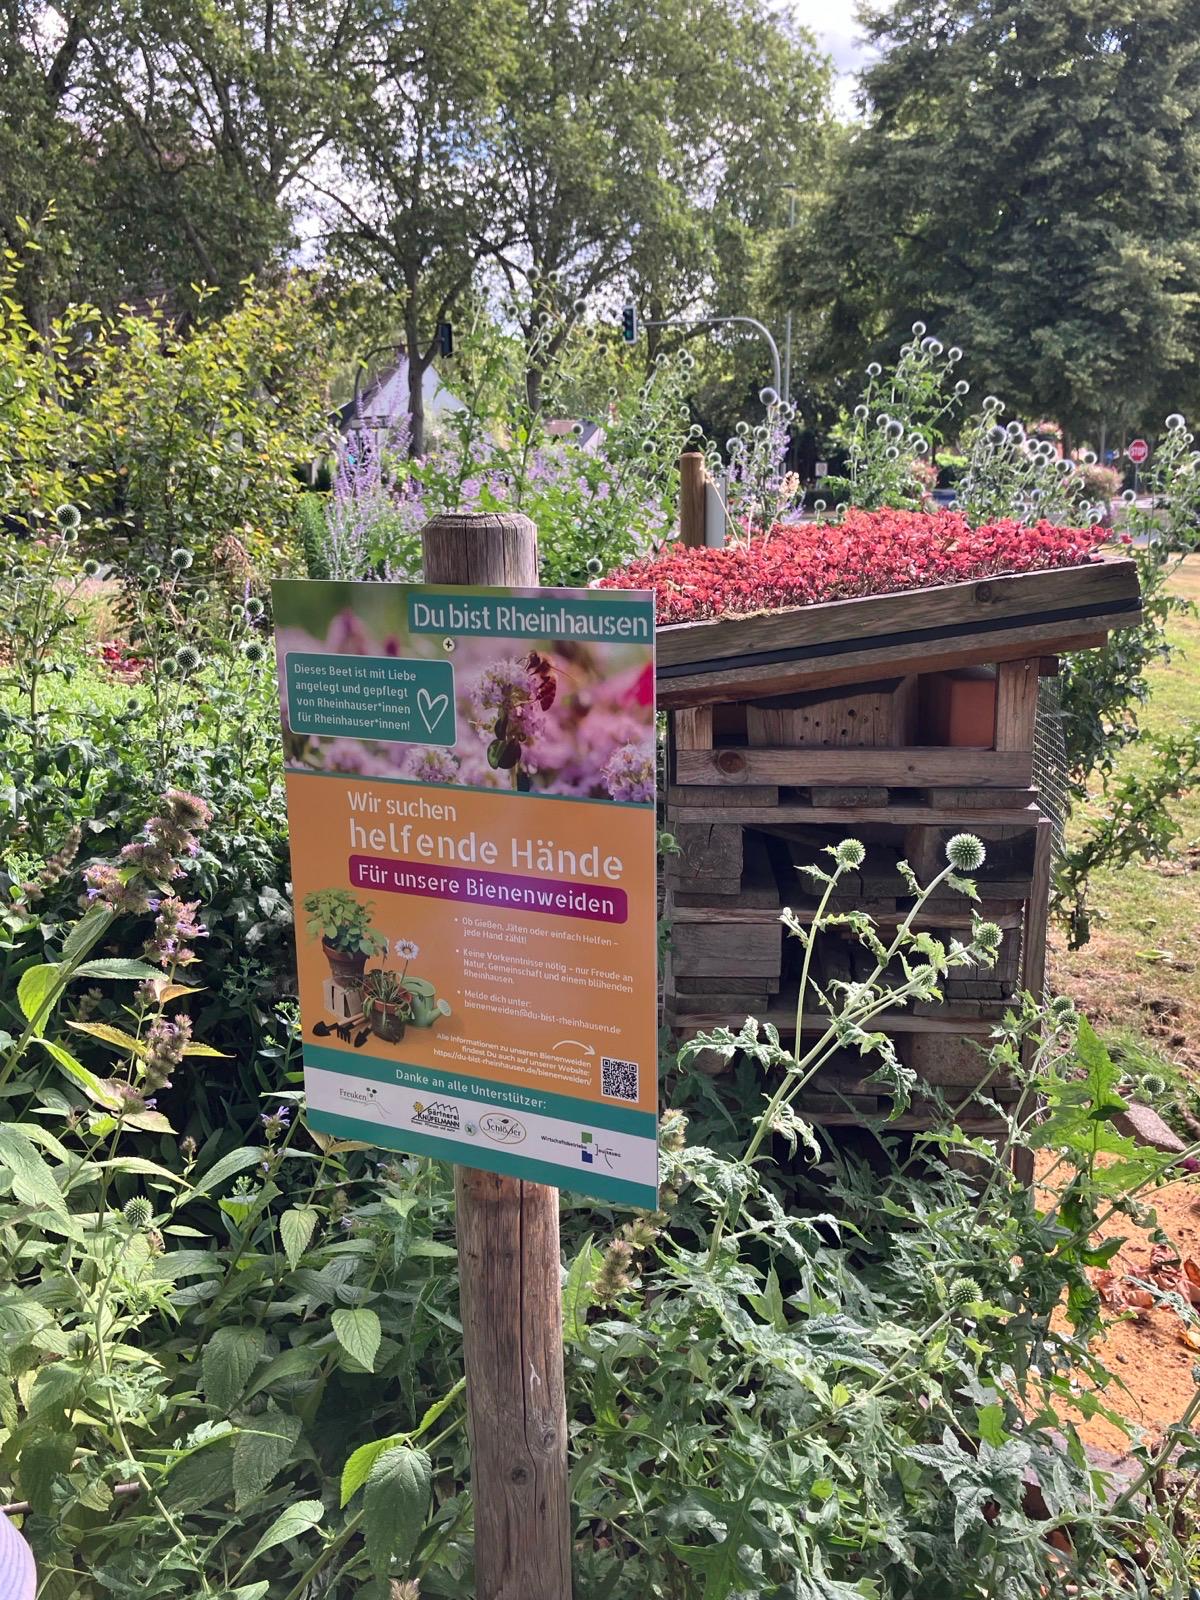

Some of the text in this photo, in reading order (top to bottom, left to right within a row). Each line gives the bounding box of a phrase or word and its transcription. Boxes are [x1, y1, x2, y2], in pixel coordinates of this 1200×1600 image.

[1130, 446, 1147, 457] STOP
[414, 603, 648, 637] Du bist Rheinhausen
[294, 663, 416, 681] Dieses Beet ist mit Liebe
[295, 680, 408, 699] angelegt und gepflegt
[297, 698, 314, 707] von
[297, 711, 311, 722] für
[348, 791, 457, 822] Wir suchen
[349, 817, 623, 880] helfende Hände
[358, 863, 614, 915] Für unsere Bienenweiden
[462, 917, 473, 926] Ob
[474, 919, 503, 931] Gießen,
[505, 922, 528, 934] Jäten
[529, 926, 549, 937] oder
[550, 929, 582, 942] einfach
[582, 934, 612, 947] Helfen
[463, 928, 527, 945] jede Hand zählt!
[463, 948, 485, 959] Keine
[486, 951, 544, 968] Vorkenntnisse
[545, 959, 567, 973] nötig
[575, 966, 589, 975] nur
[591, 968, 620, 981] Freude
[622, 974, 633, 983] an
[463, 959, 633, 993] Natur, Gemeinschaft und einem blühenden
[463, 969, 514, 985] Rheinhausen.
[464, 990, 532, 1008] Melde dich unter:
[436, 1033, 449, 1041] Alle
[450, 1034, 499, 1050] Informationen
[510, 1047, 538, 1058] unseren
[539, 1050, 591, 1068] Bienenweiden
[462, 1046, 591, 1077] findest Du auch auf unserer Website:
[339, 1088, 367, 1101] Freuken
[395, 1069, 547, 1110] Danke an alle Unterstützer:
[427, 1108, 459, 1121] Gärtnerei
